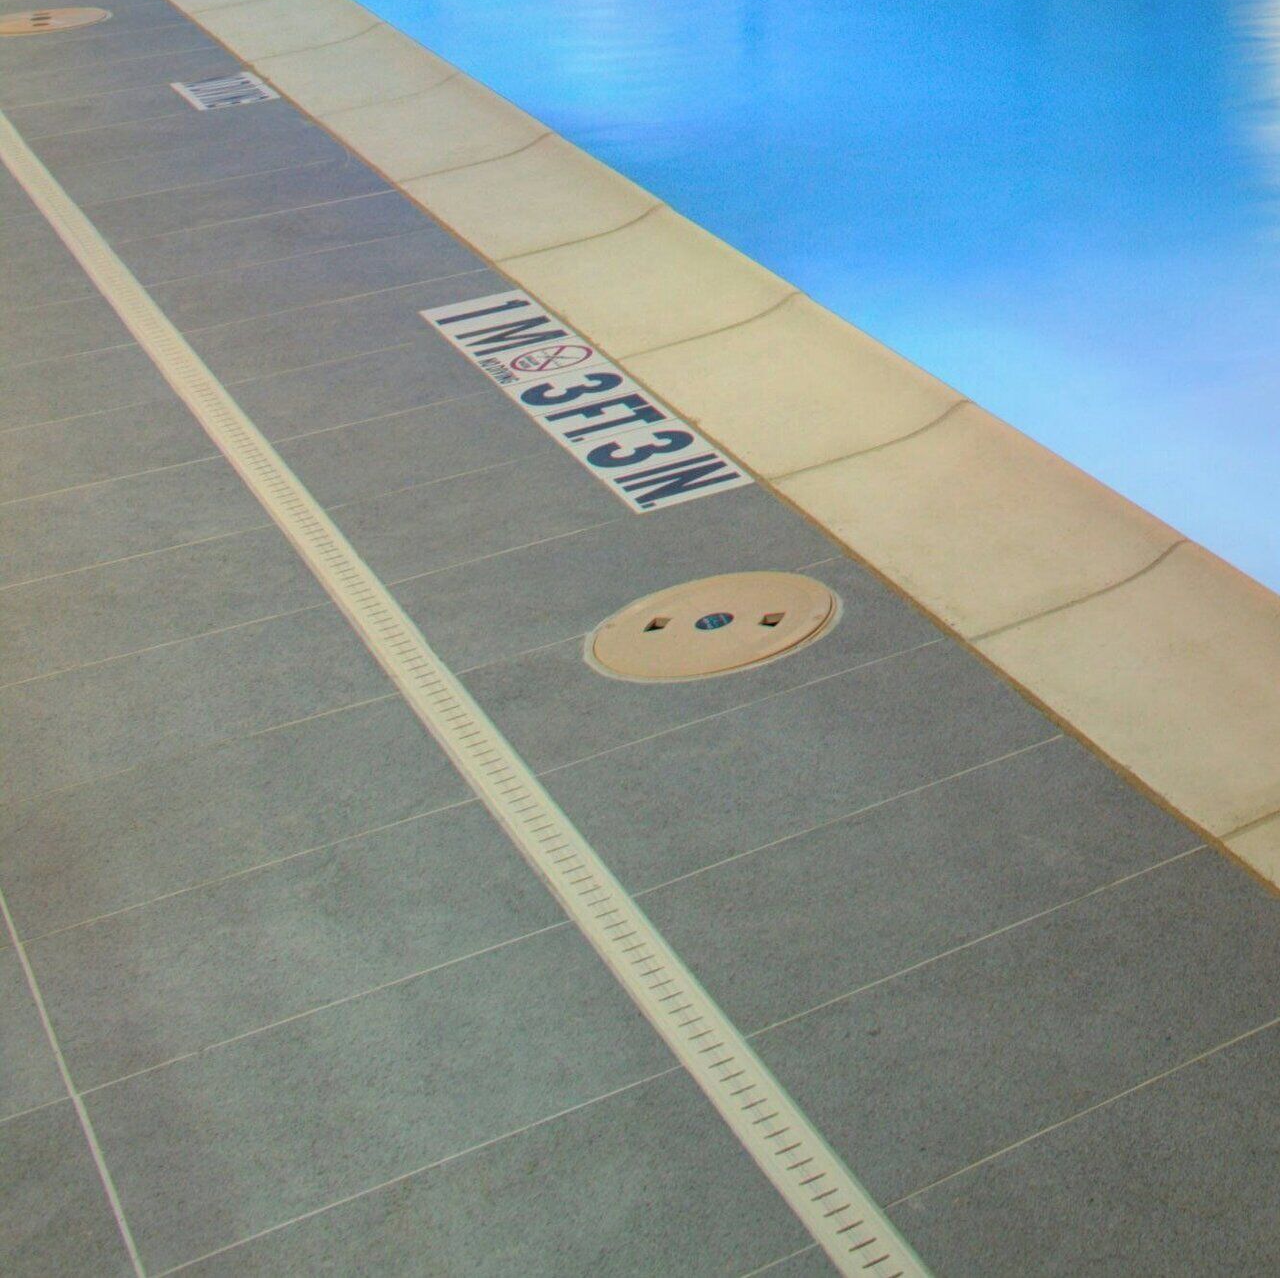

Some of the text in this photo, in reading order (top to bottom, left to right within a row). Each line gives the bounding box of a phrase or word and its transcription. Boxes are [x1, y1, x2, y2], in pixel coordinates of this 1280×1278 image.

[436, 299, 740, 510] 1 M 3 FT. 3 IN.
